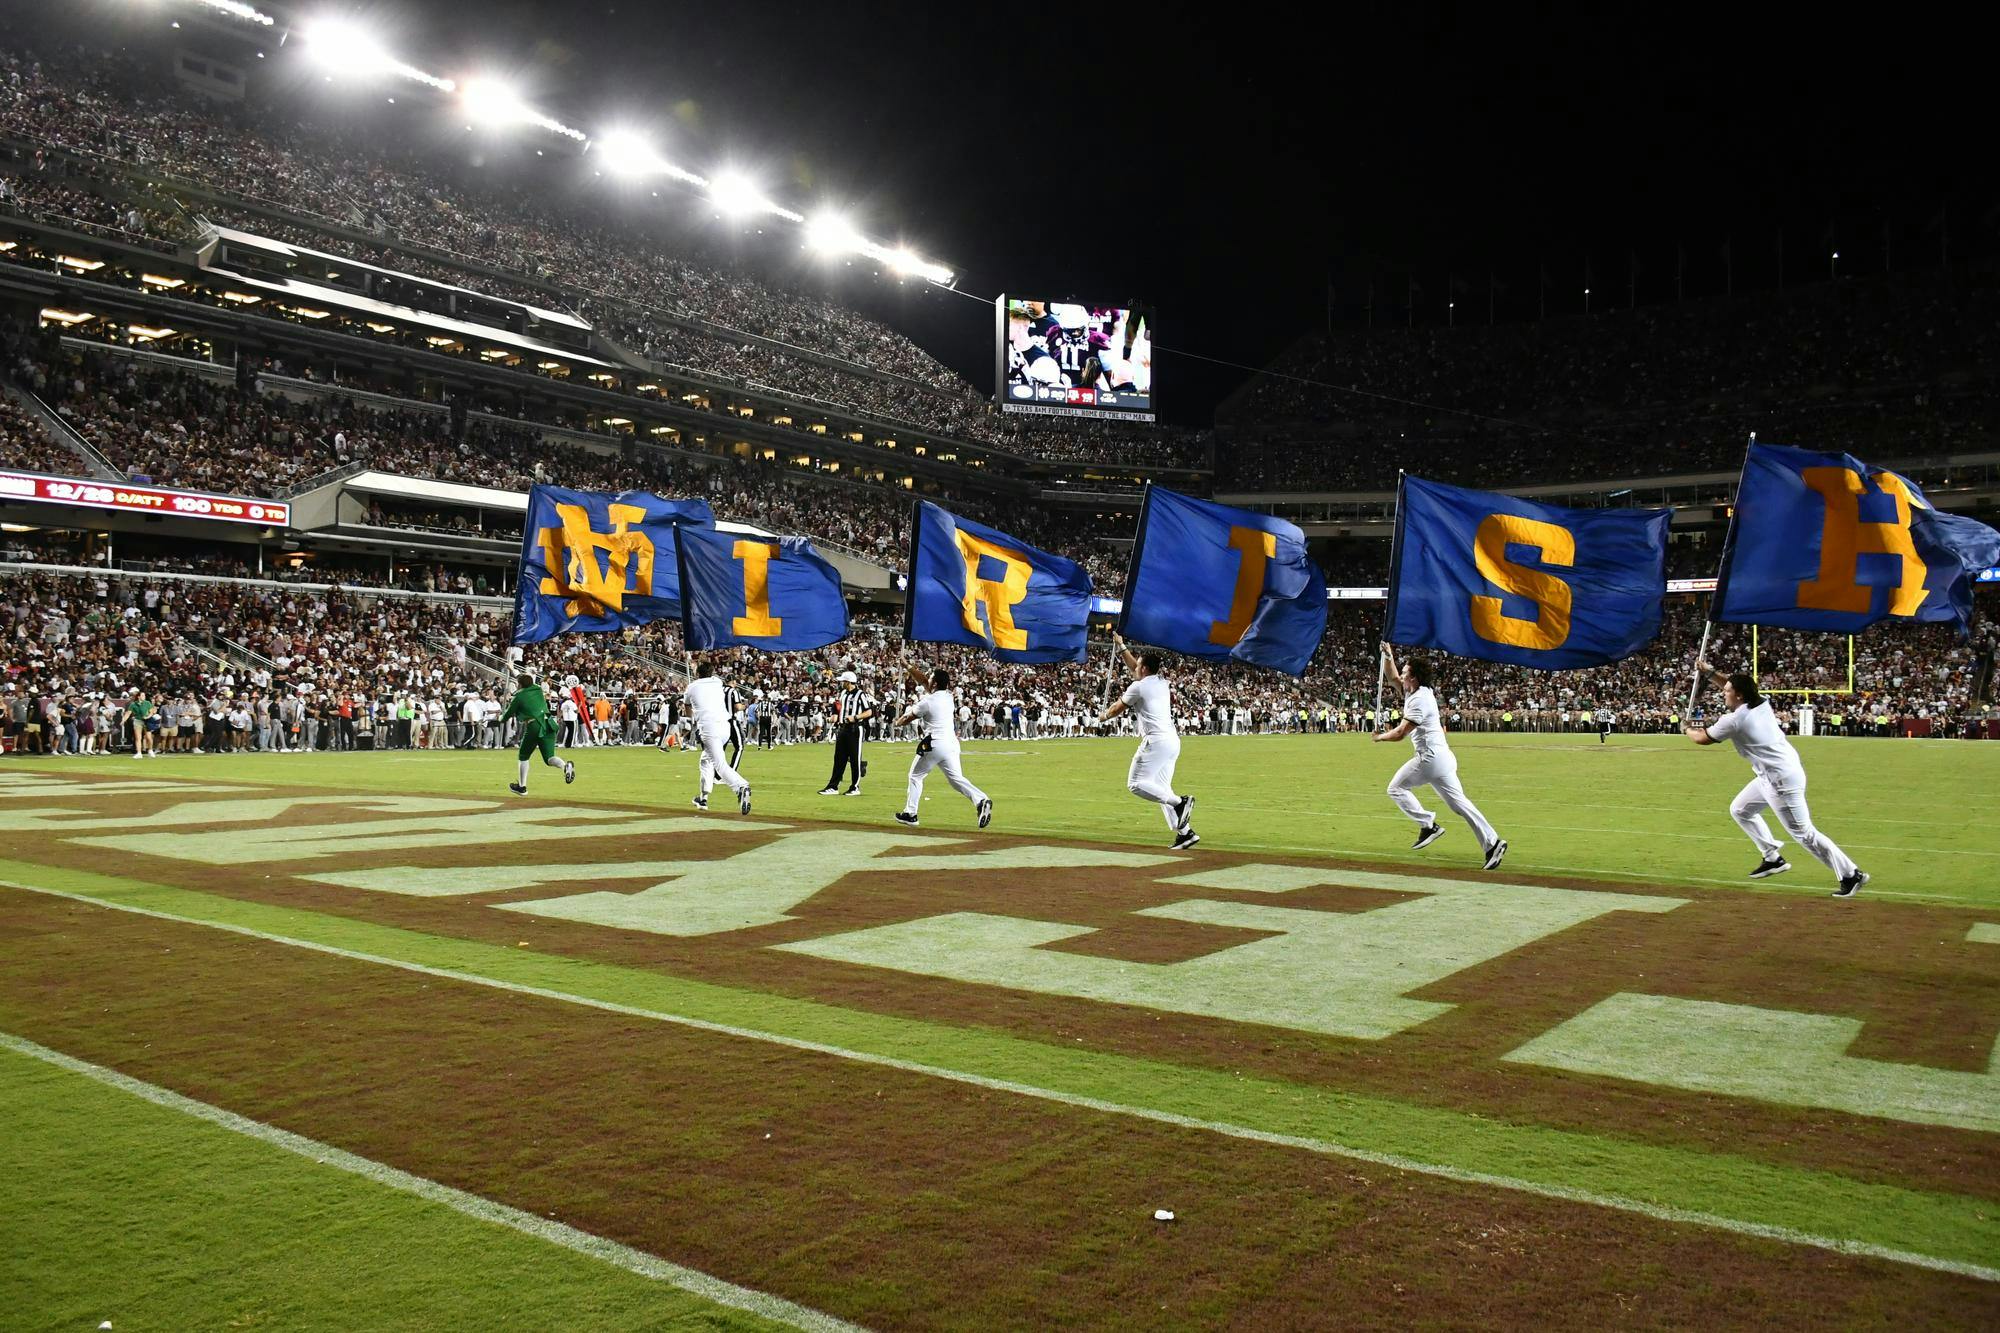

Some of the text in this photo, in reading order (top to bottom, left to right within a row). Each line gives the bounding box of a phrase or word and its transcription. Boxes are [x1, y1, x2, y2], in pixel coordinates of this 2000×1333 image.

[1013, 404, 1033, 412] TEXAS
[1048, 407, 1078, 416] FOOTBALL
[172, 496, 211, 513] 100
[212, 502, 243, 515] YDS
[248, 504, 265, 519] 0
[265, 508, 286, 520] TD
[732, 539, 782, 637] I
[954, 527, 1033, 651] R
[1470, 513, 1577, 651] S
